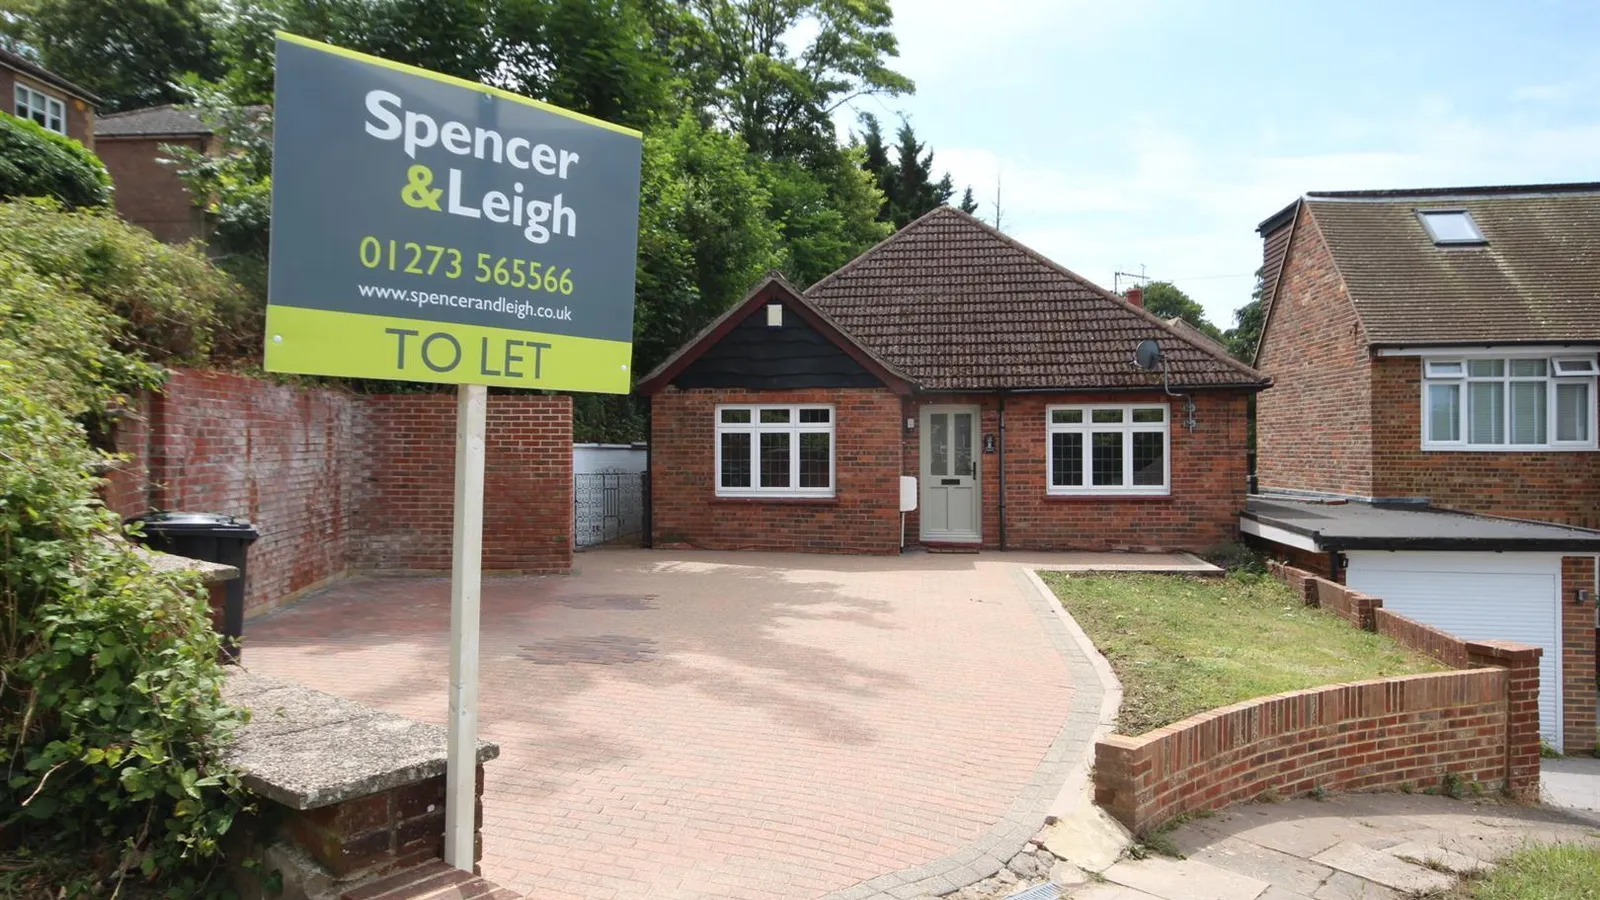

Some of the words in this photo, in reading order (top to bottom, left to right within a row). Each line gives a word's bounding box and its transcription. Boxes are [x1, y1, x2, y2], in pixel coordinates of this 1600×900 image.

[365, 90, 579, 179] Spencer
[359, 236, 462, 279] 01273
[475, 253, 574, 295] 565566
[358, 283, 572, 321] www.spencerandleigh.co.uk
[385, 328, 462, 373] TO
[480, 337, 552, 379] LET
